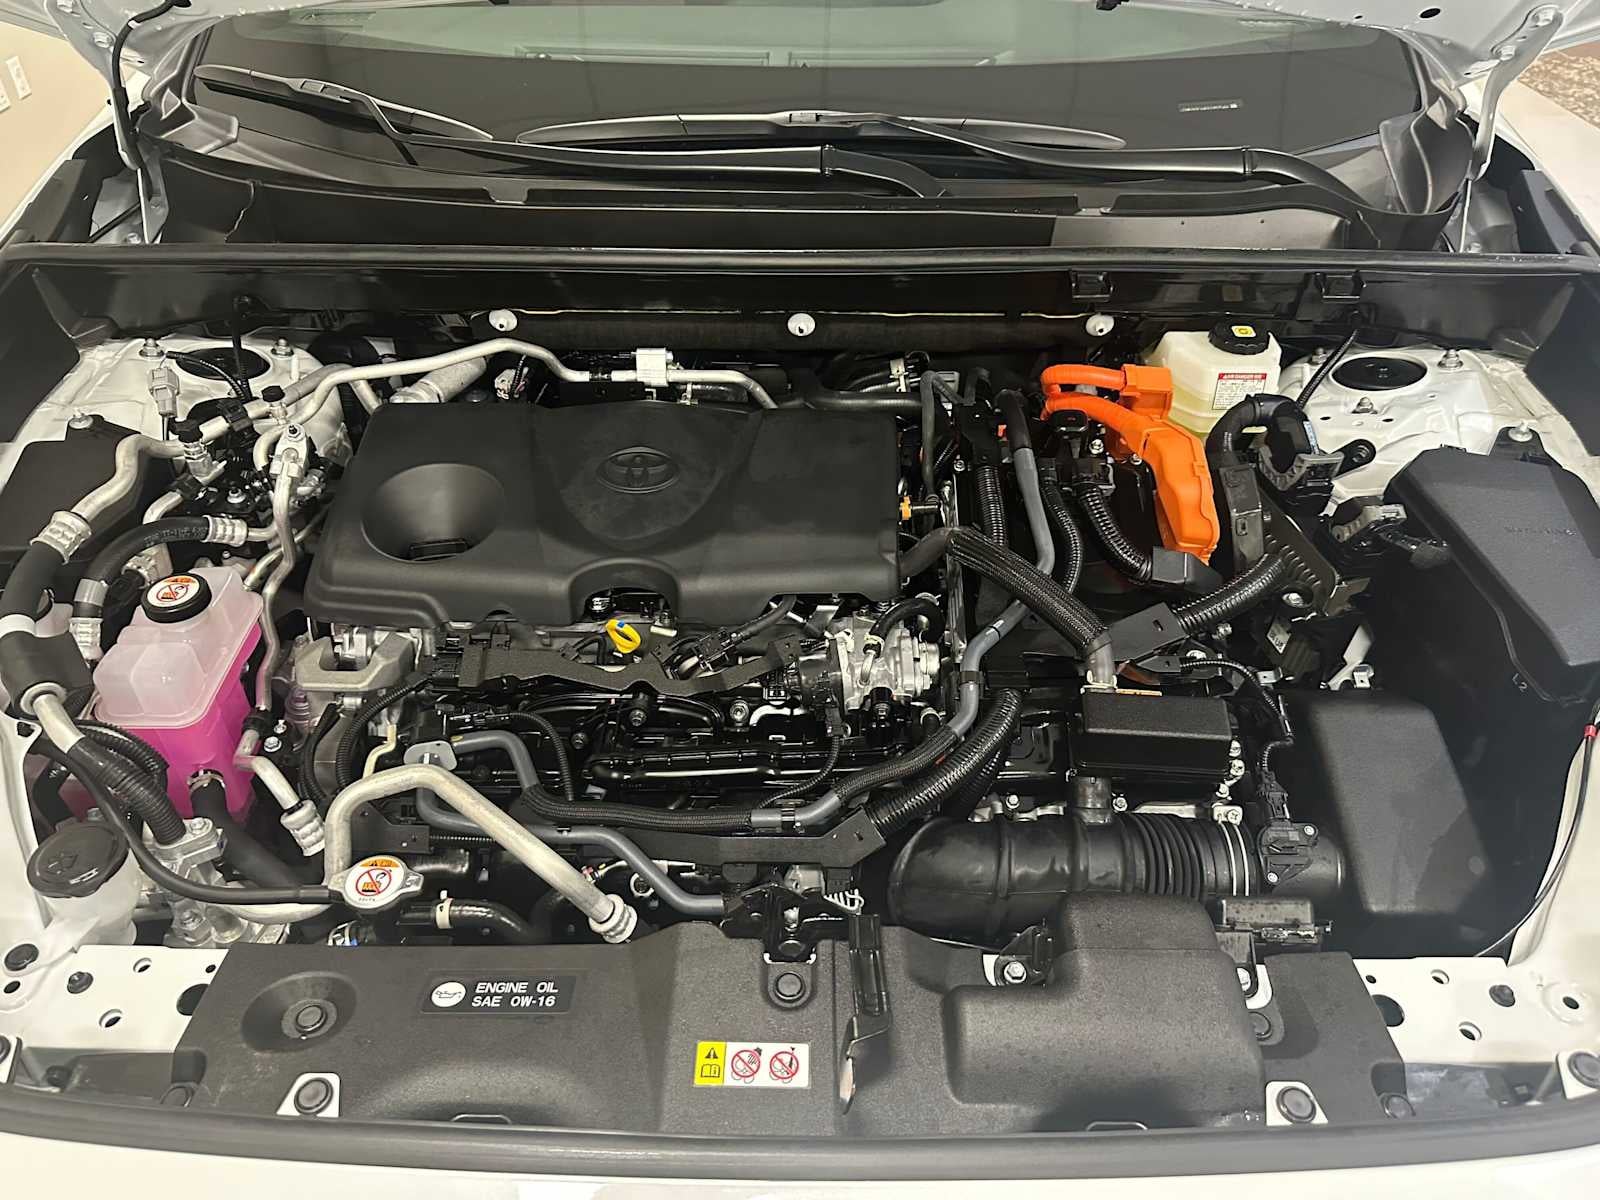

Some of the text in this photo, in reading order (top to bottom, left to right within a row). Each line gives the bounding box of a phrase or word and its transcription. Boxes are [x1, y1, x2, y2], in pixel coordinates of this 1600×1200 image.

[475, 982, 559, 994] ENGINE OIL
[471, 995, 556, 1007] SAE 0W-16
